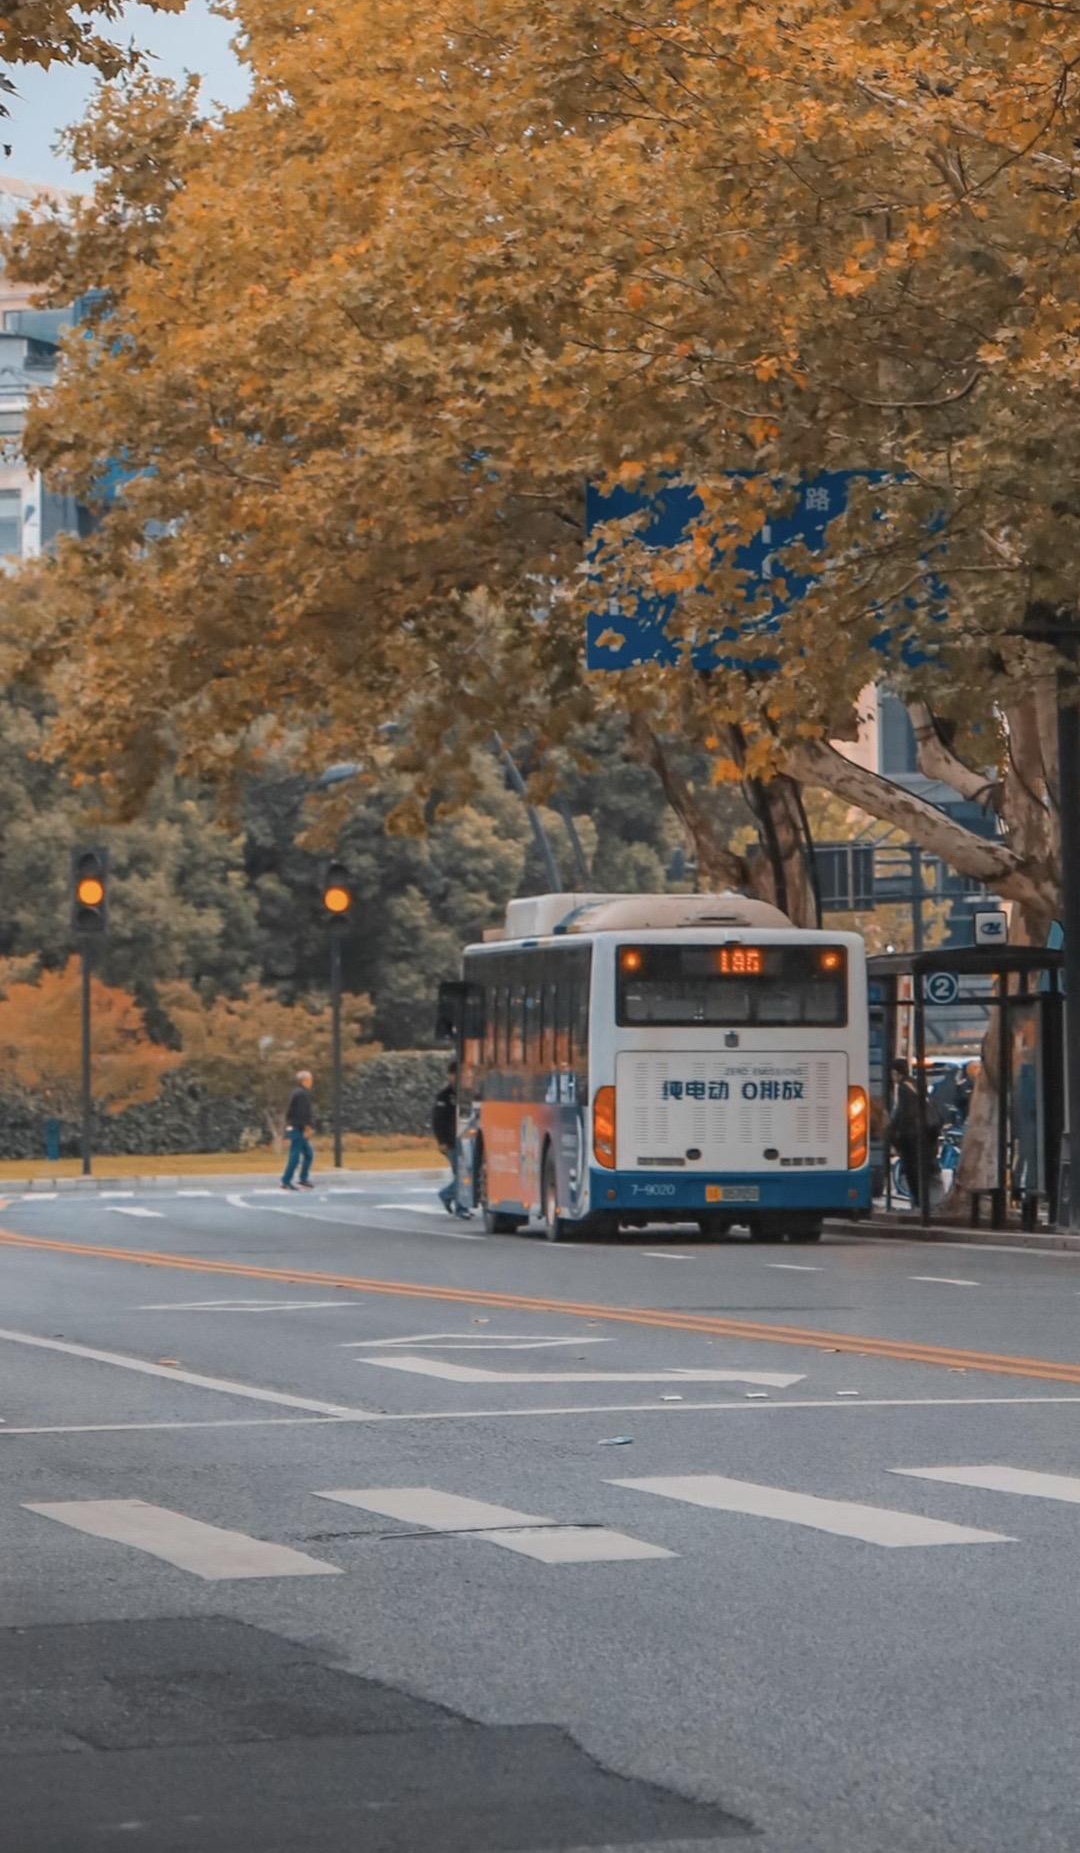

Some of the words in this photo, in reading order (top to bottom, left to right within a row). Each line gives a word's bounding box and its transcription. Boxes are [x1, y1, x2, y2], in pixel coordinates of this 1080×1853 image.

[935, 978, 950, 996] 2
[662, 1080, 730, 1101] 纯电动
[630, 1183, 676, 1196] 7-9020
